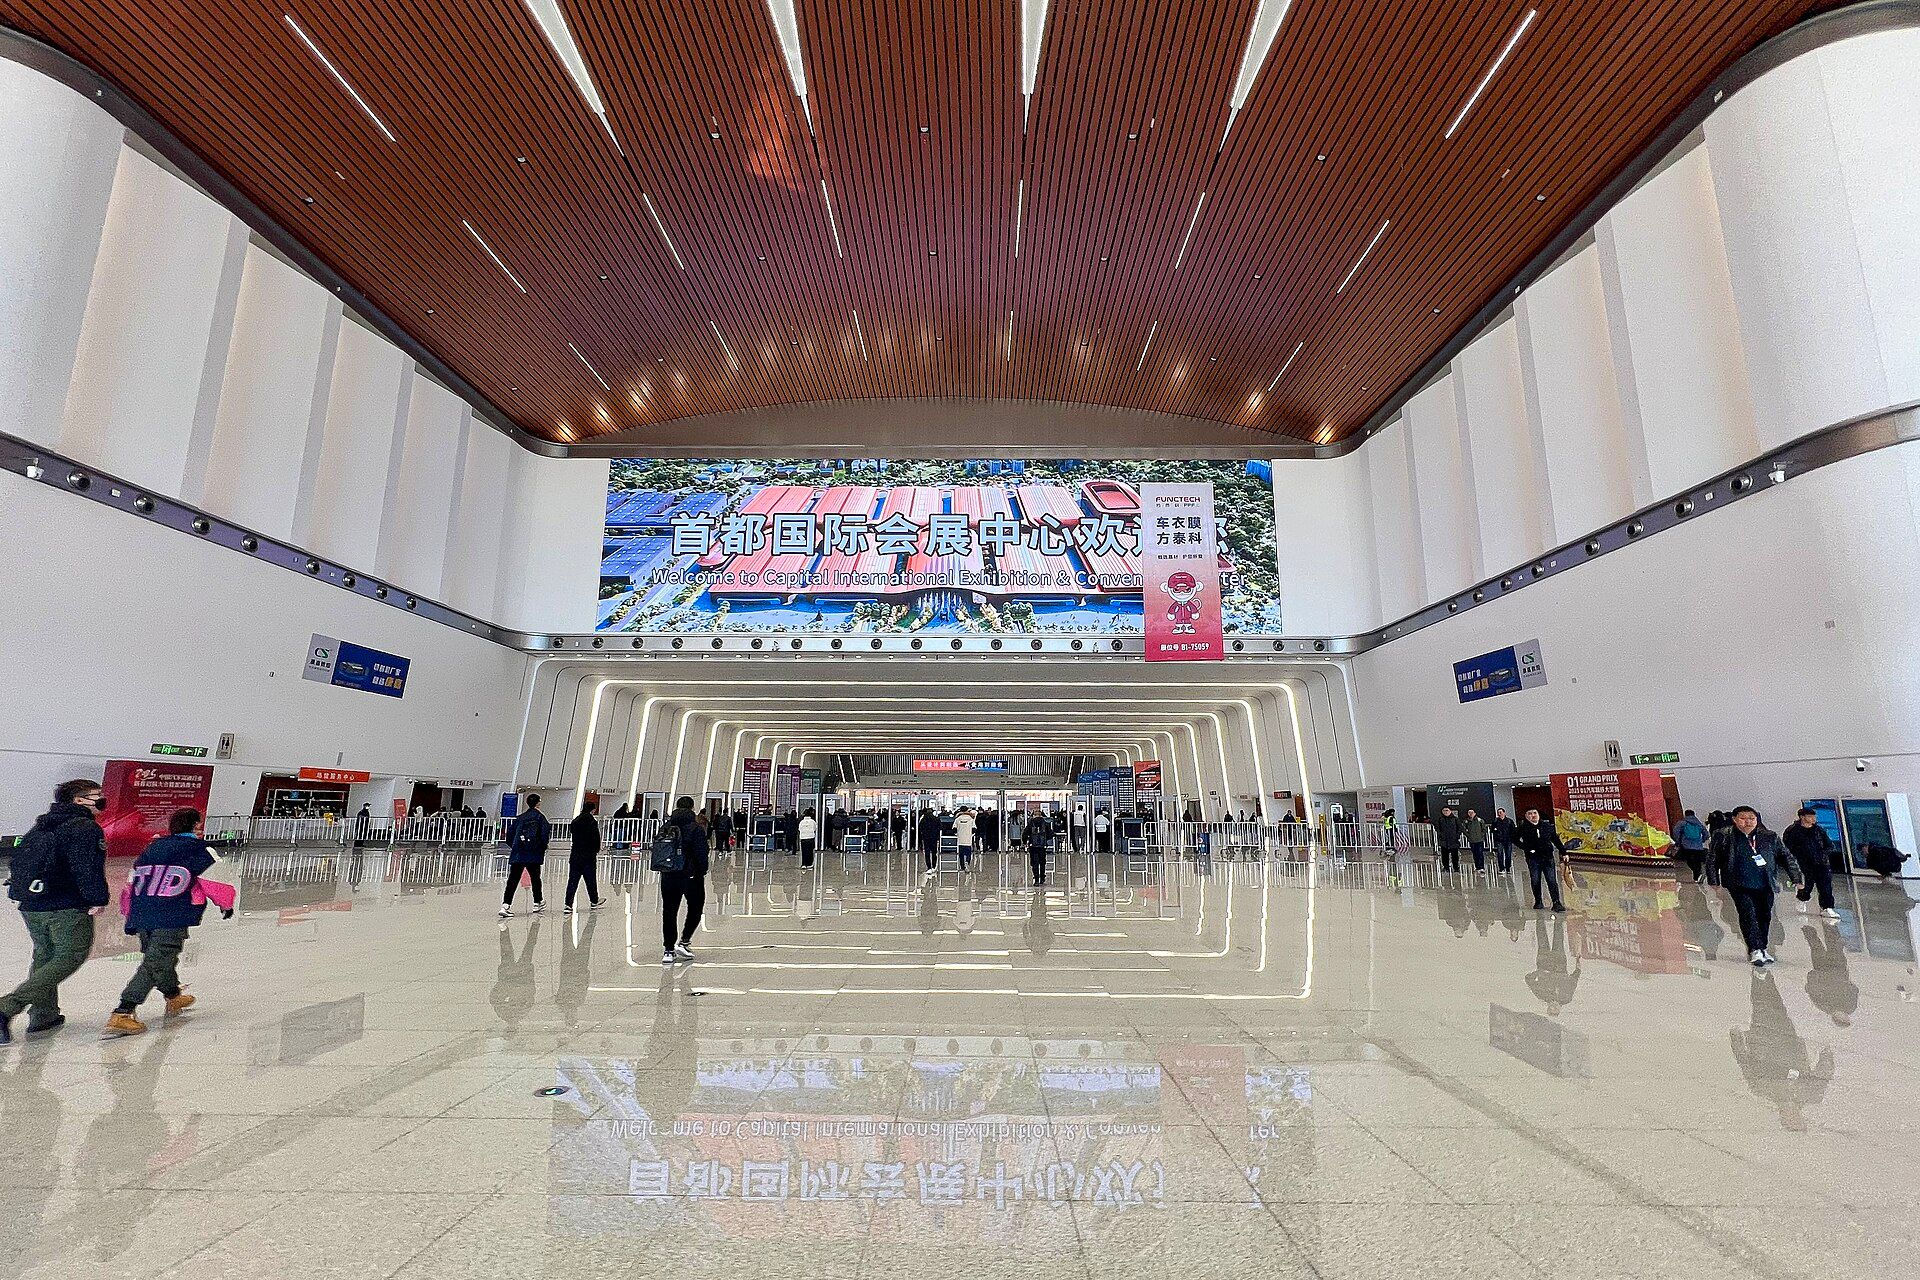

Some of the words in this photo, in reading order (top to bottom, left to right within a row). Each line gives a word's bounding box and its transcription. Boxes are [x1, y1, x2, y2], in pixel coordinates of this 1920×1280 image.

[1156, 516, 1202, 530] 车衣膜
[1156, 531, 1203, 546] 方泰科
[652, 569, 735, 585] Welcome
[739, 571, 758, 585] to
[762, 569, 829, 588] Capital
[834, 569, 954, 585] International
[959, 569, 1051, 586] Exhibition
[1056, 571, 1070, 586] &
[1074, 570, 1143, 586] Conven
[1567, 775, 1579, 788] 01
[1579, 774, 1601, 784] GRAND
[1602, 773, 1619, 783] PRIX
